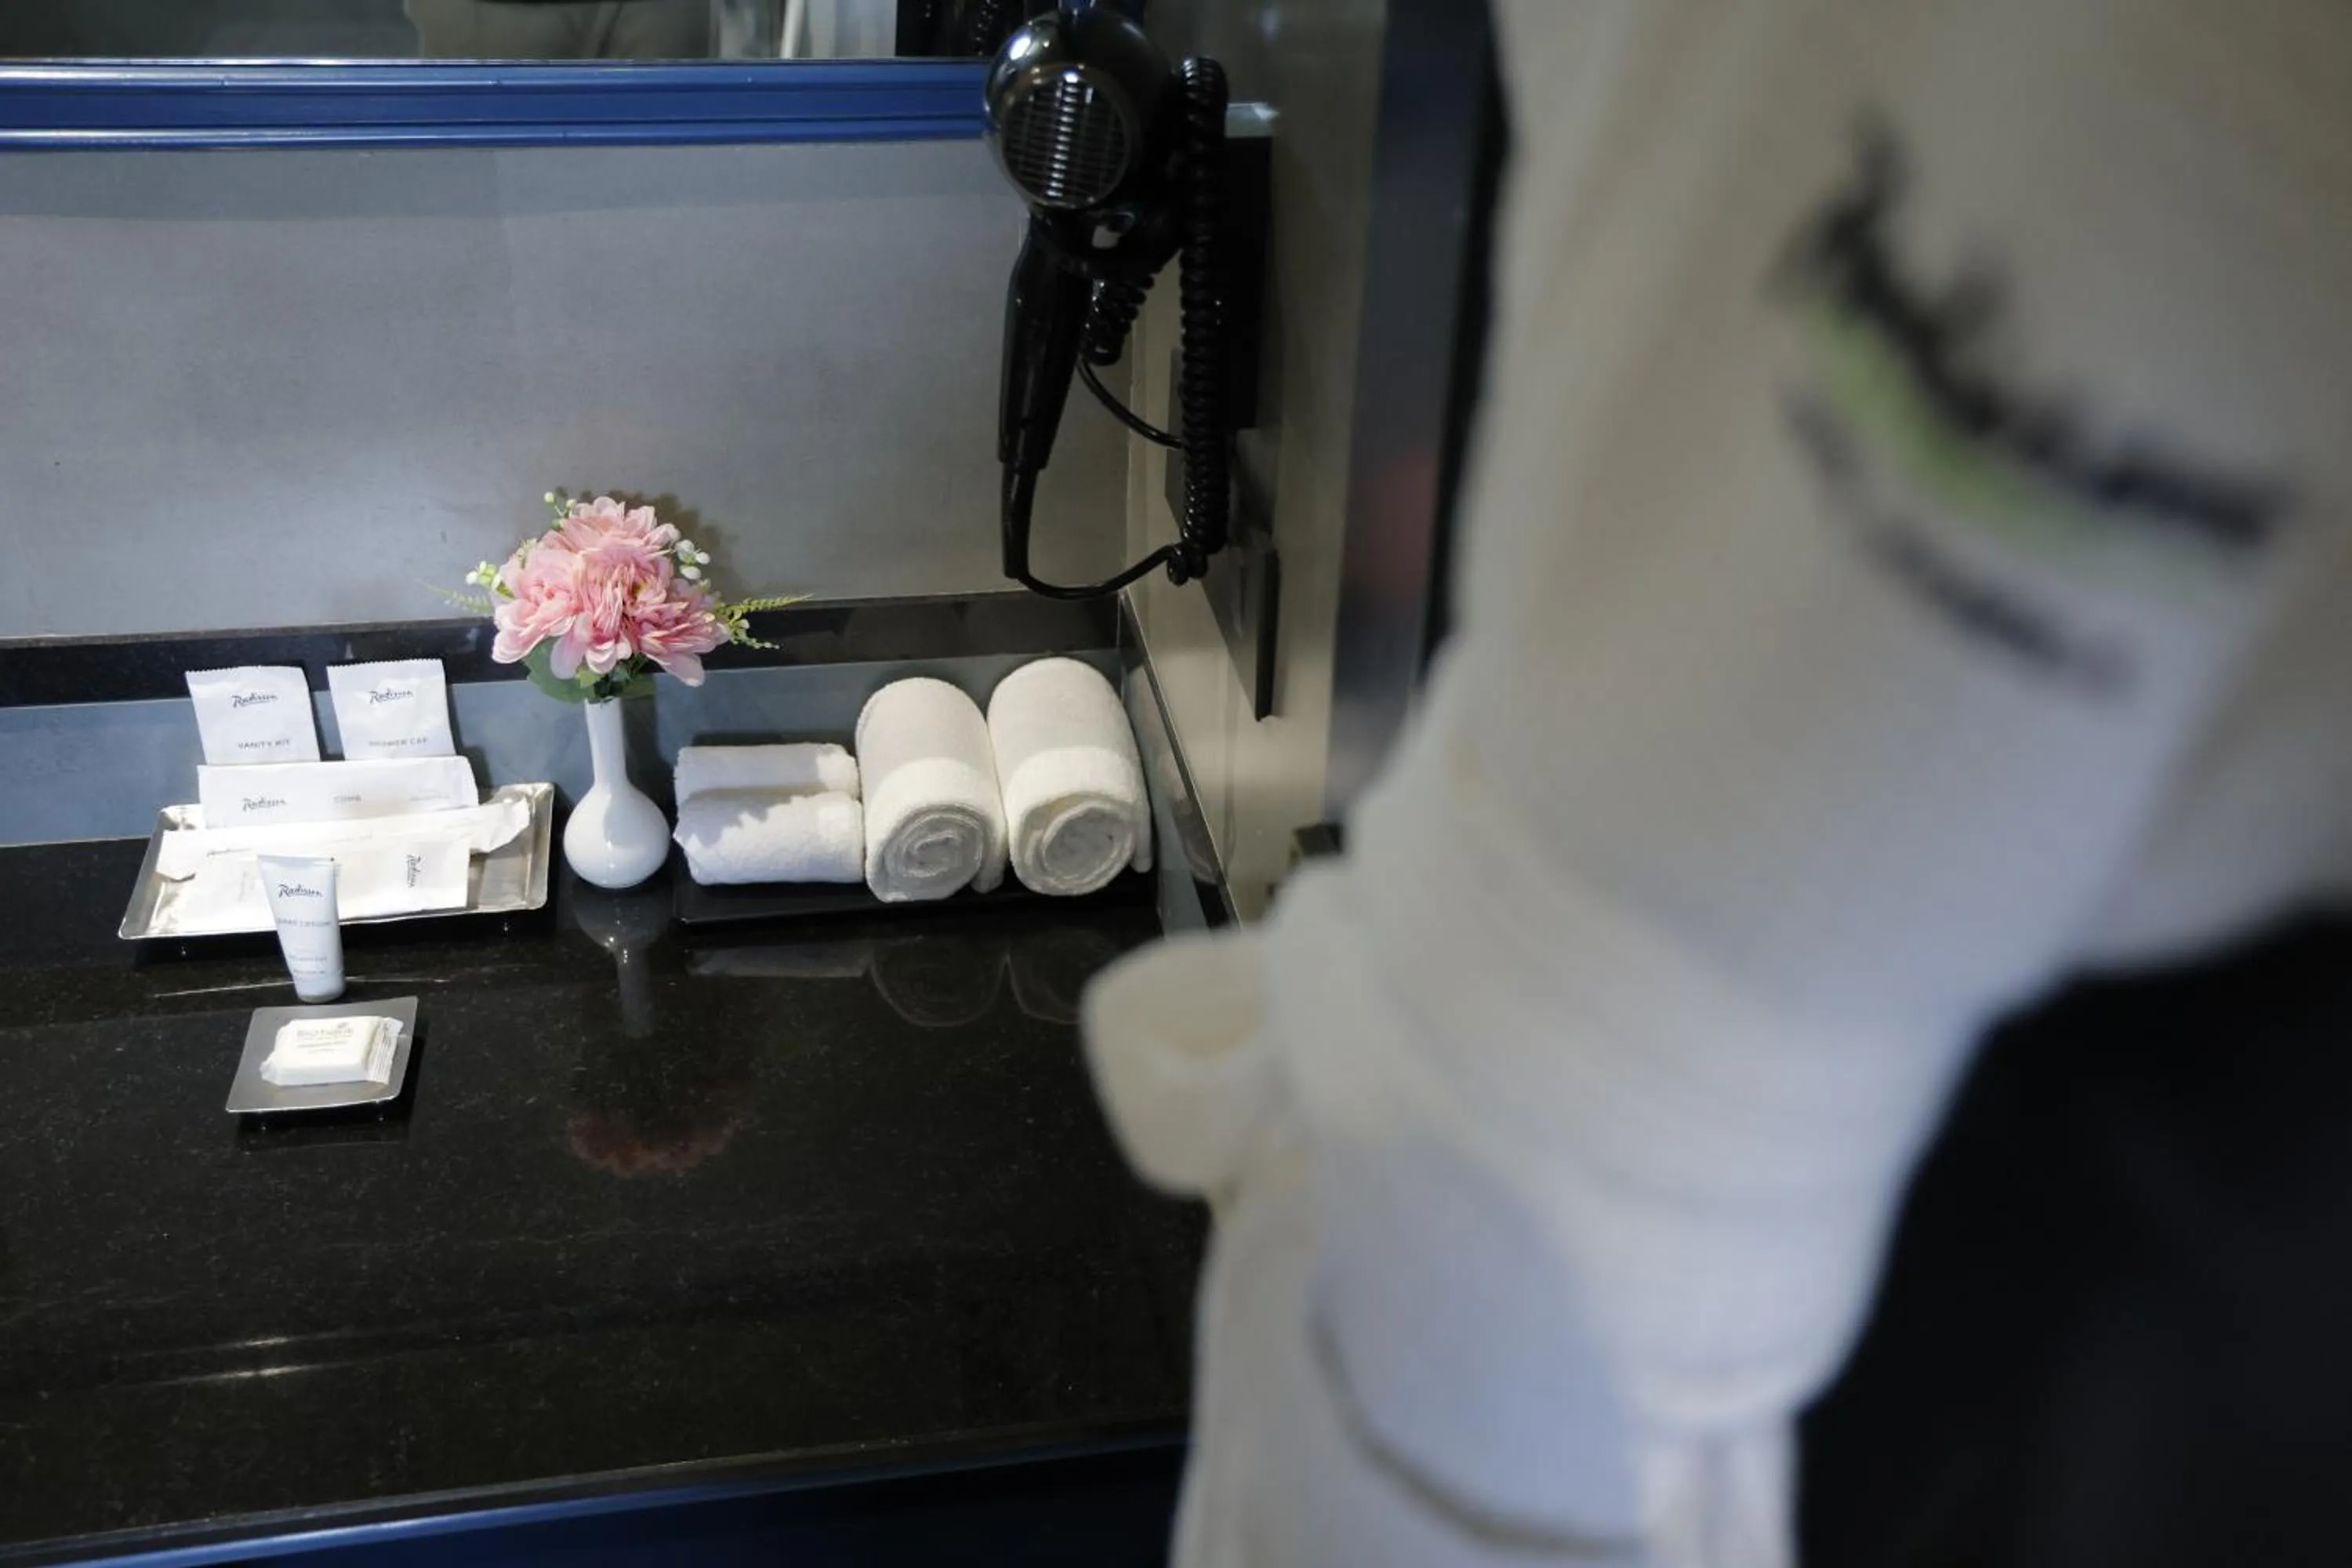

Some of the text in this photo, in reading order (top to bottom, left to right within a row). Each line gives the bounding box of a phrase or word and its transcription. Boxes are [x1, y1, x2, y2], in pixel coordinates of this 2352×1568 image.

[231, 691, 278, 708] Radisson
[368, 688, 413, 703] Radisson
[278, 884, 324, 898] Radisson
